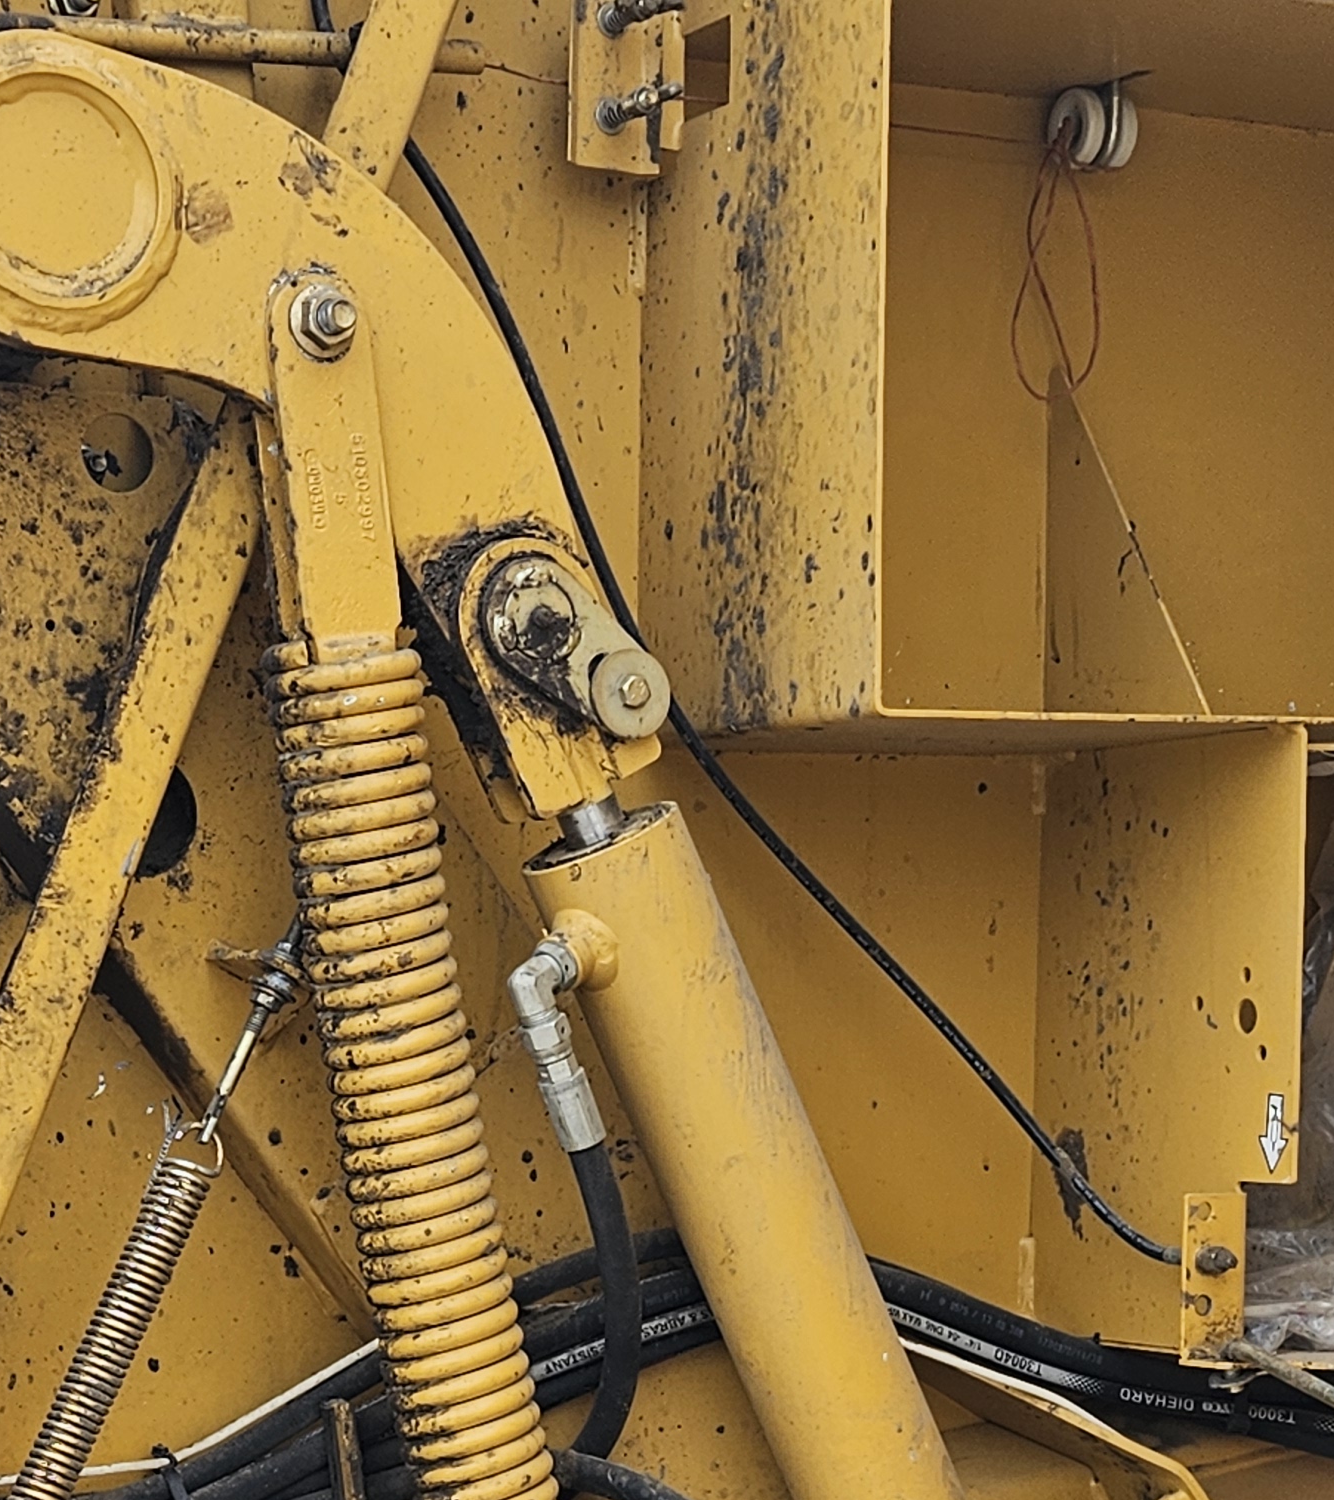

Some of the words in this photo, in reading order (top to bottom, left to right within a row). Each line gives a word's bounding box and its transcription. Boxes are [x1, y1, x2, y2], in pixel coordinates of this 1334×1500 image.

[642, 1314, 686, 1339] ABRAS
[544, 1342, 605, 1375] ESISTANT
[994, 1347, 1042, 1377] T3004D
[1119, 1387, 1195, 1411] DIEHARD
[1248, 1405, 1297, 1424] T3000
